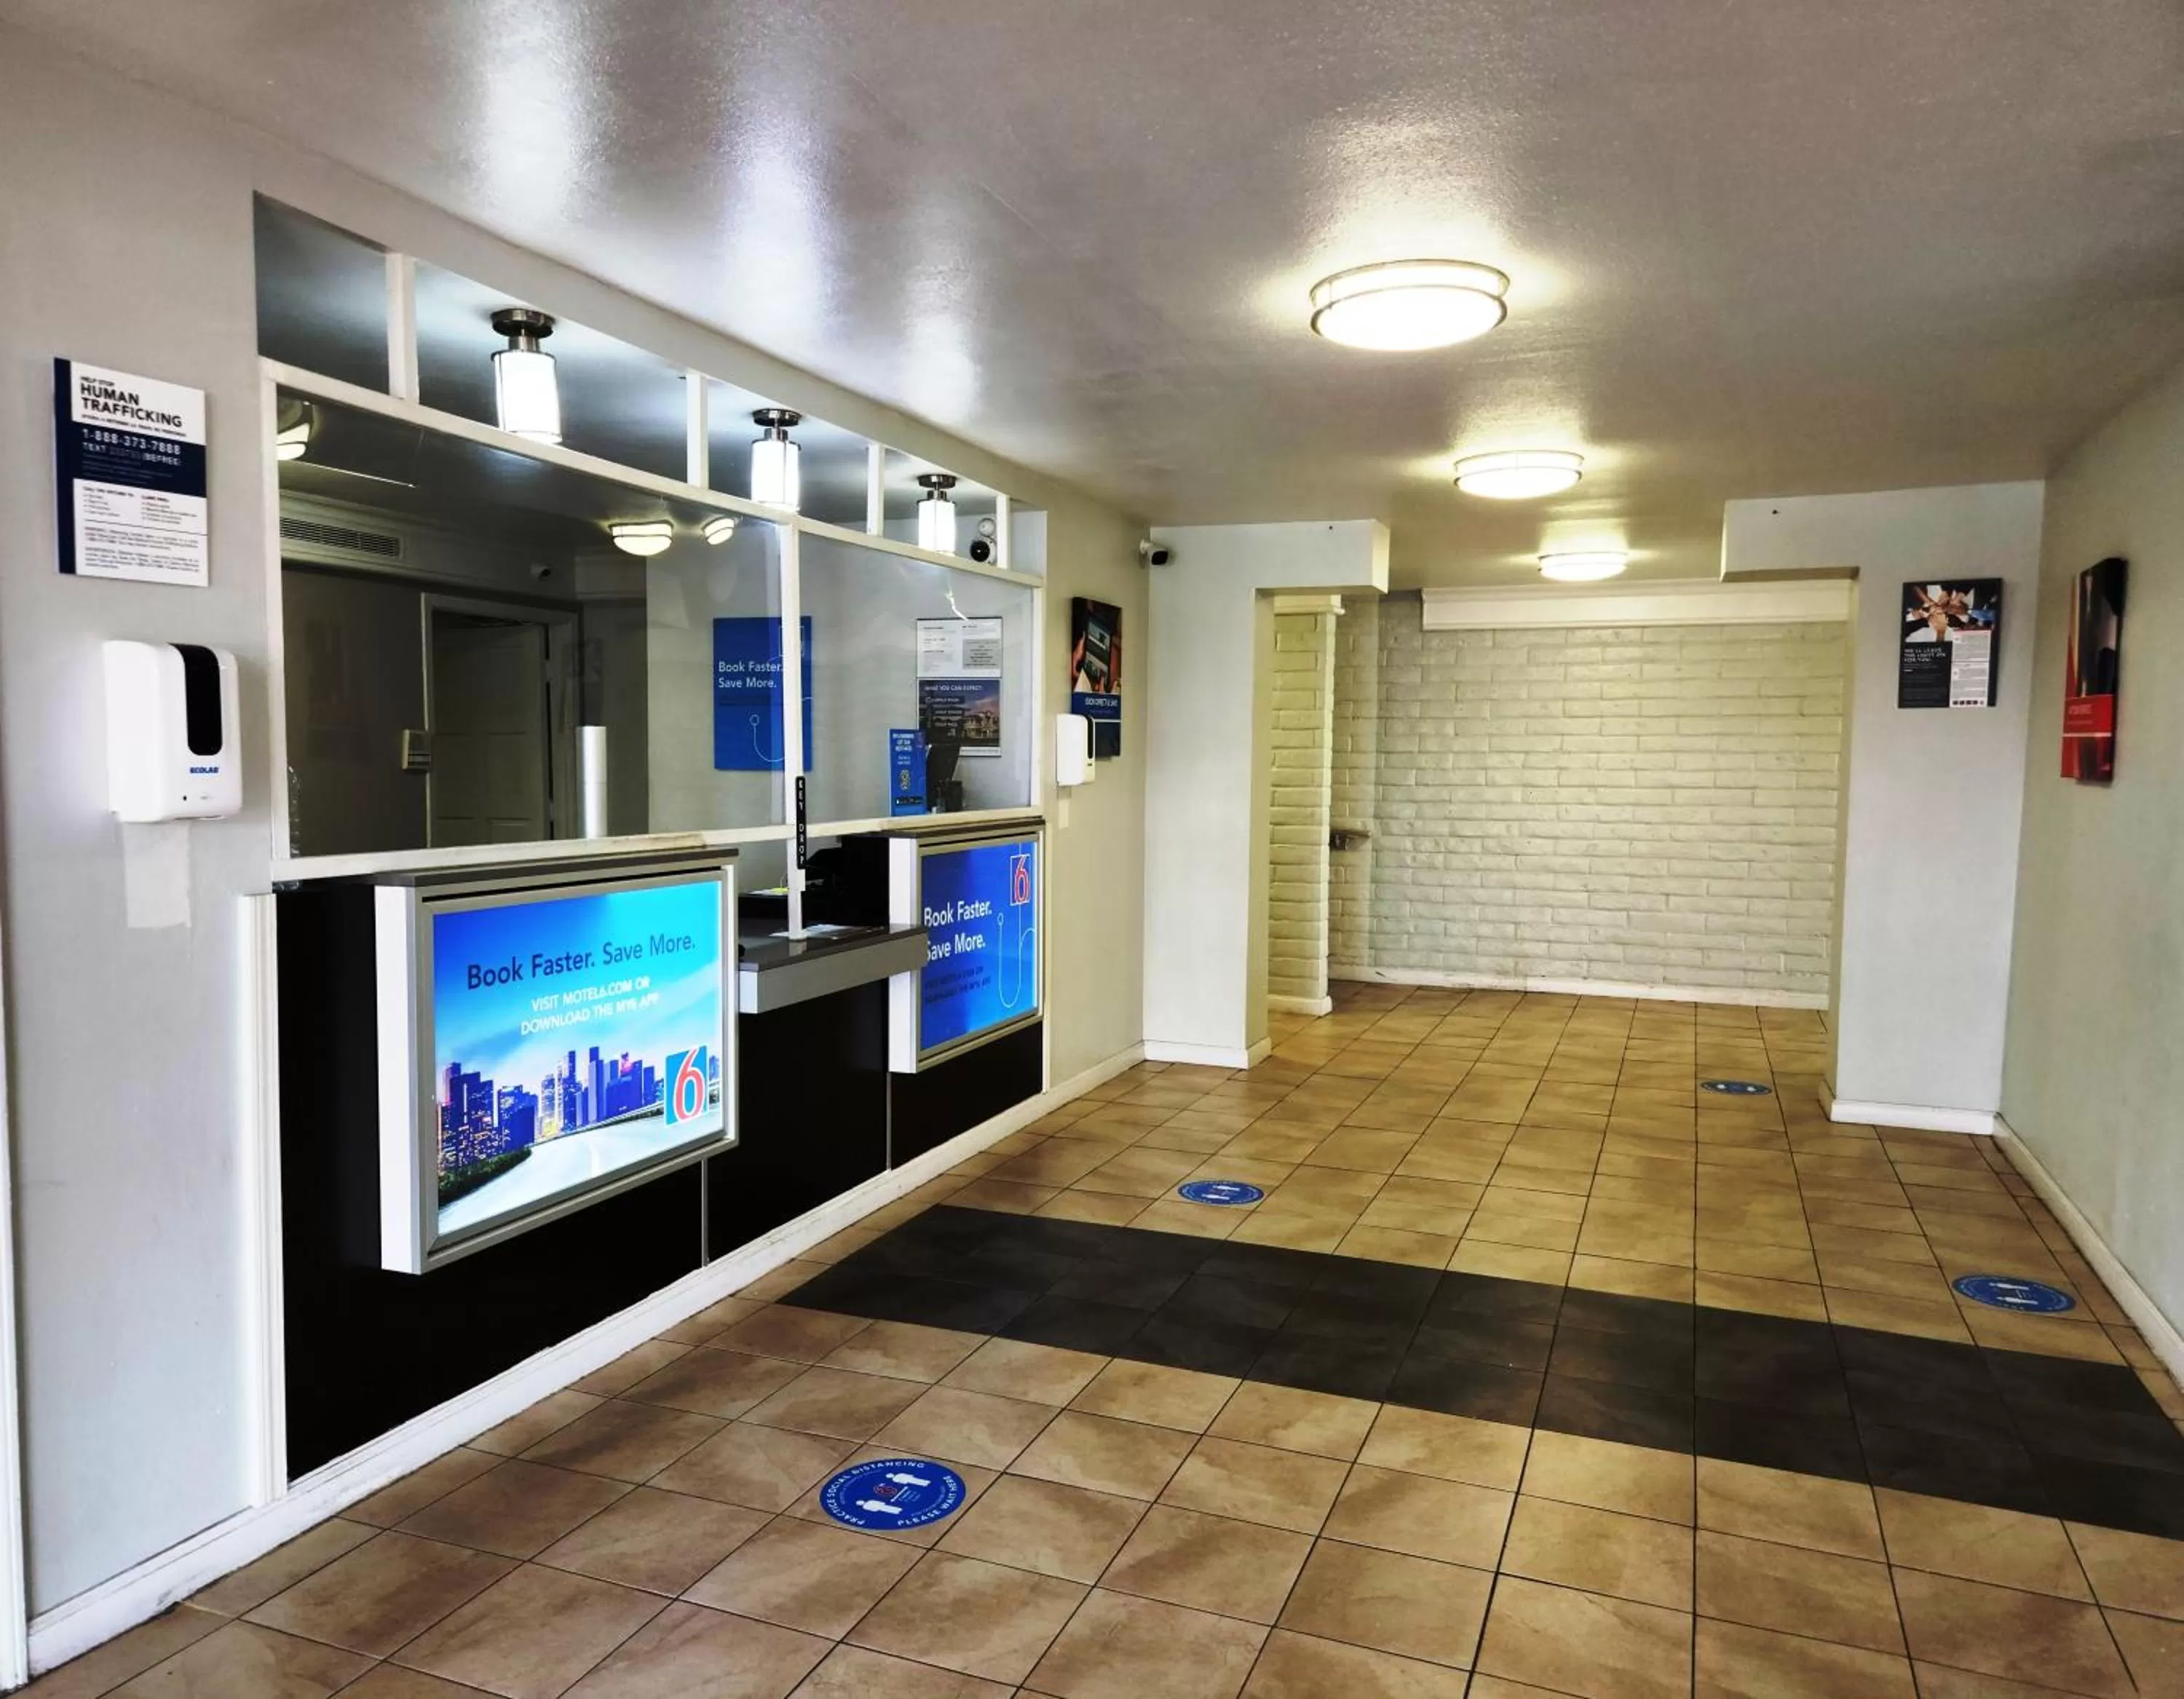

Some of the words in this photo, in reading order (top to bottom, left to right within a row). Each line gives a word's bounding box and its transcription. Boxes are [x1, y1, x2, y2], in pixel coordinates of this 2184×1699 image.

[81, 381, 140, 406] HUMAN
[82, 397, 183, 428] TRAFFICKING
[82, 428, 181, 456] 1-888-373-7888
[719, 660, 745, 672] Book
[719, 676, 743, 688] Save
[746, 676, 778, 688] More.
[924, 901, 954, 927] Book
[957, 900, 992, 920] Faster.
[954, 932, 986, 954] More.
[467, 956, 524, 991] Book
[531, 951, 595, 978] Faster.
[603, 941, 643, 966] Save
[649, 933, 695, 957] More.
[531, 994, 560, 1013] VISIT
[562, 978, 632, 1009] MOTEL6.COM
[635, 975, 651, 990] OR
[521, 1008, 590, 1036] DOWNLOAD
[593, 1001, 614, 1019] THE
[639, 992, 660, 1009] APP
[671, 1046, 705, 1122] 6
[851, 1461, 925, 1475] DISTANCING
[826, 1475, 851, 1497] SOCIAL
[826, 1499, 866, 1525] PRACTICE
[897, 1508, 941, 1526] PLEASE
[940, 1492, 957, 1509] WAIT
